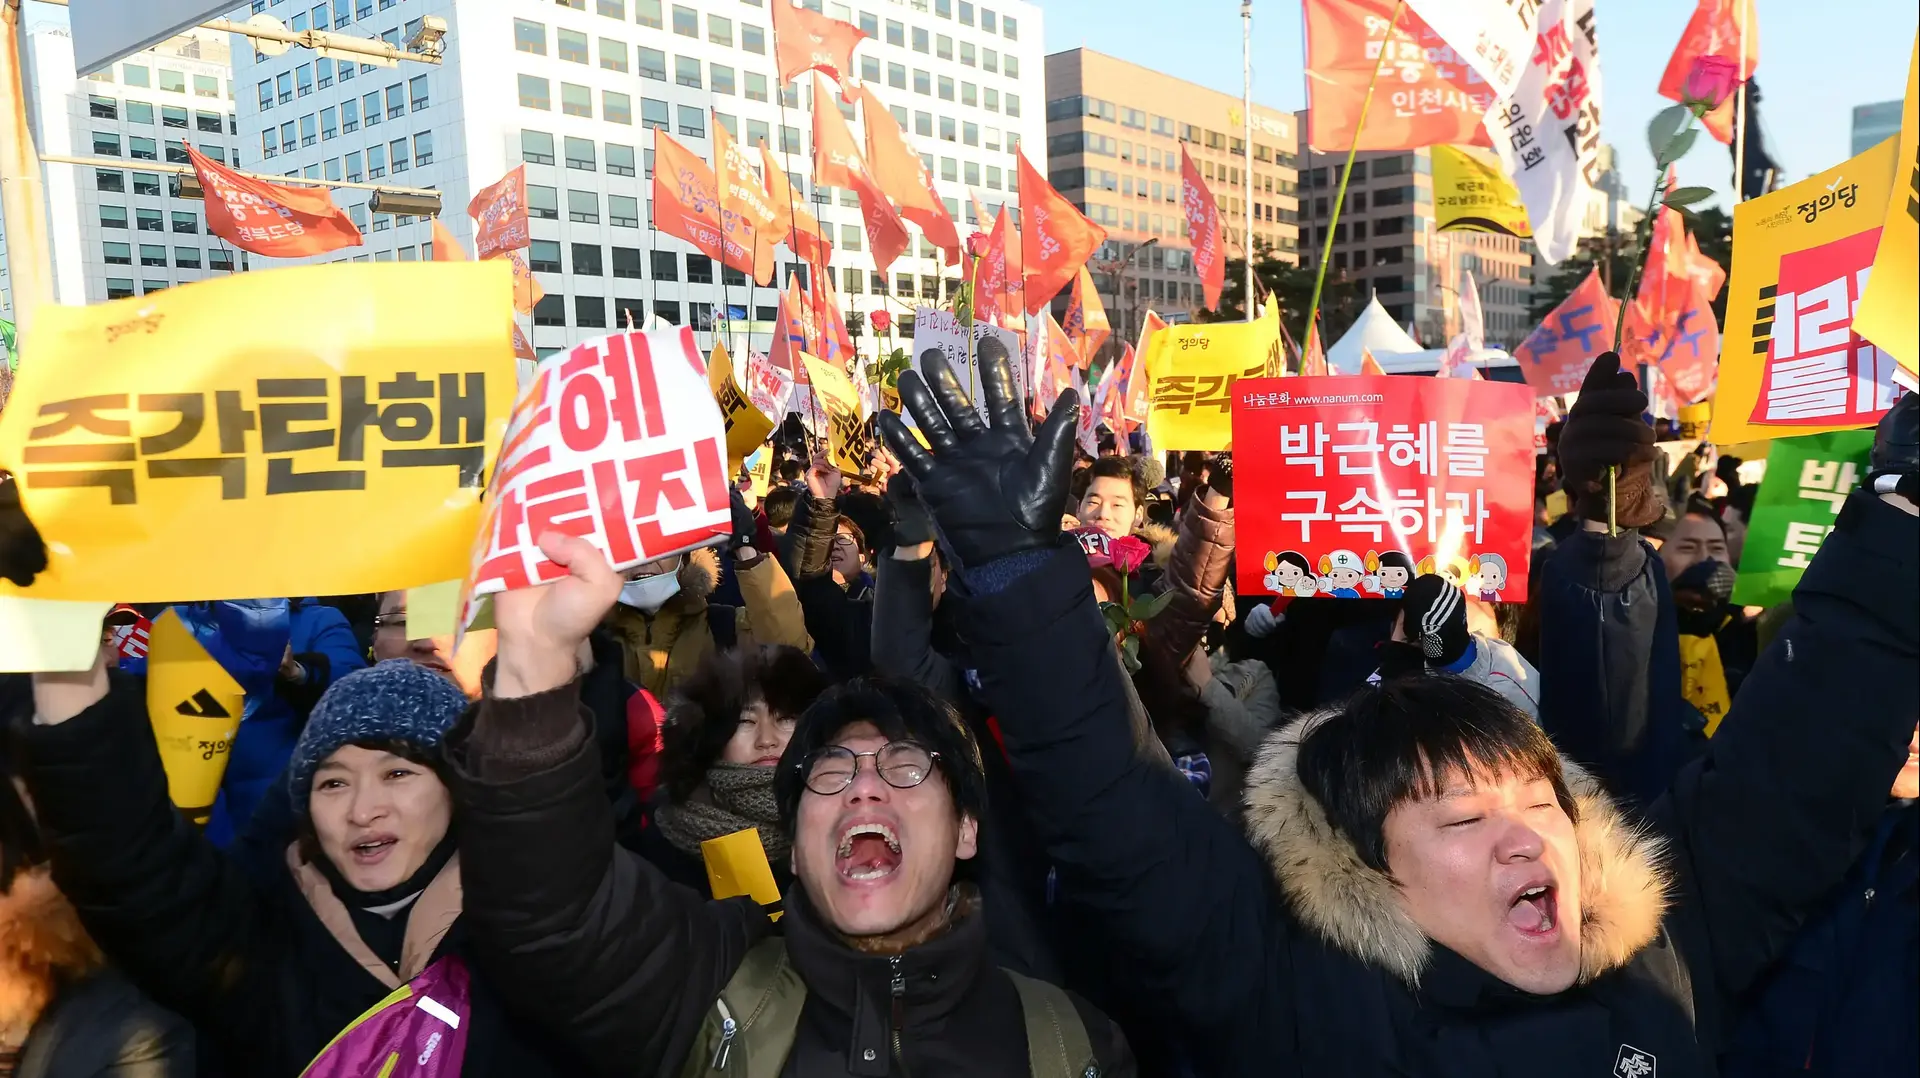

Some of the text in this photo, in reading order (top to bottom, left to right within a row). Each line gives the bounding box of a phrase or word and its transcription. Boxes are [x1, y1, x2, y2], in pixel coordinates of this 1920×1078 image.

[1797, 183, 1858, 223] 정의당
[237, 222, 305, 242] 경북도당
[1178, 338, 1210, 350] 정의당
[1243, 391, 1384, 407] 나눔문화 www.nanum.com
[24, 372, 486, 505] 즉각탄핵
[1280, 421, 1489, 477] 박근혜를
[1281, 487, 1490, 545] 구속하라
